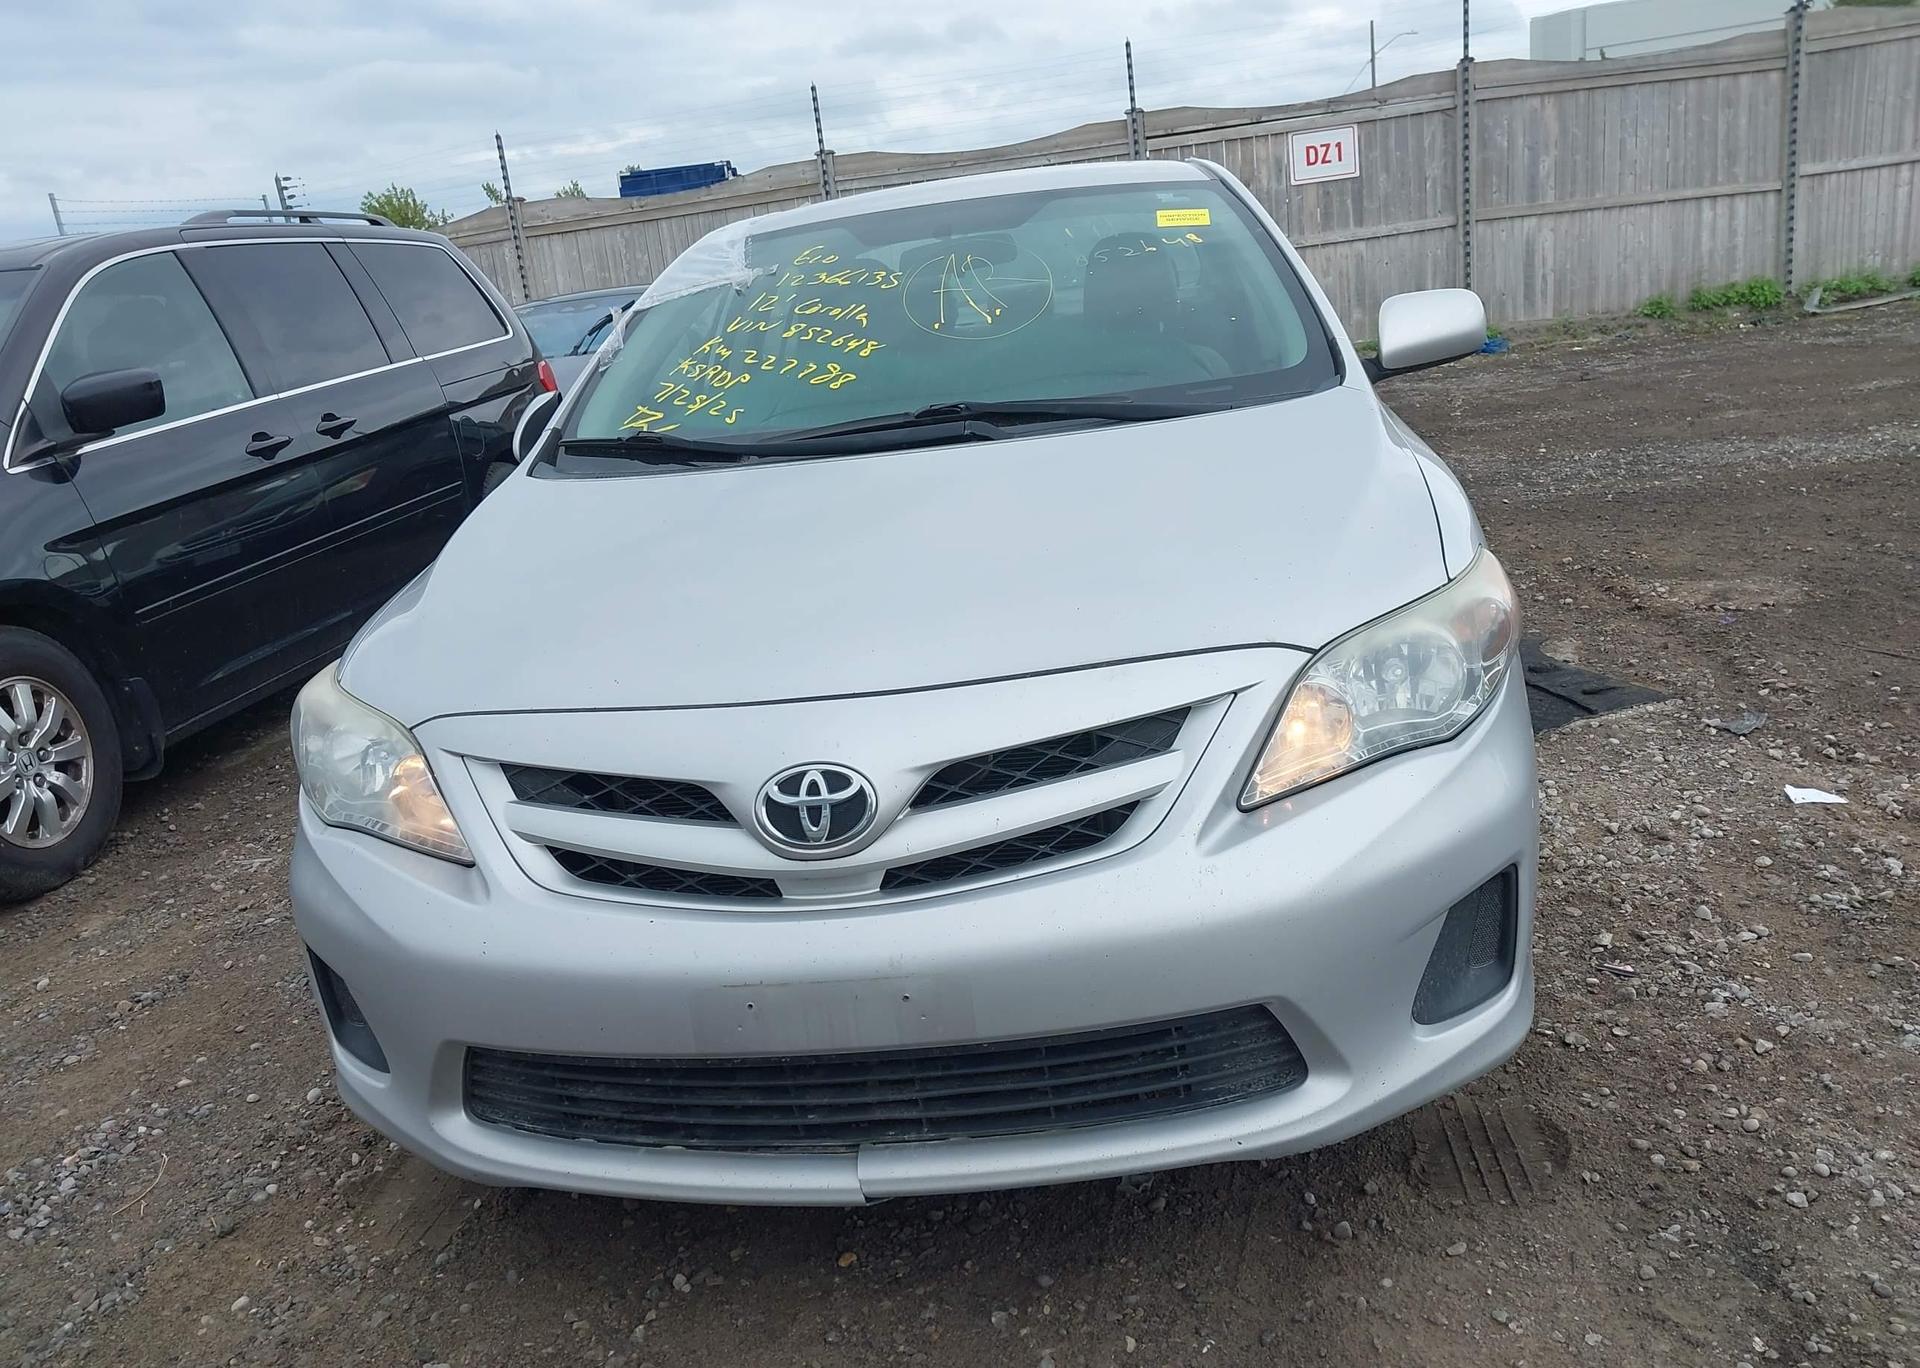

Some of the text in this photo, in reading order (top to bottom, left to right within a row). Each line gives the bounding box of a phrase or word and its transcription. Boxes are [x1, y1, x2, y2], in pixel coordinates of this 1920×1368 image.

[1305, 141, 1343, 166] DZ1
[794, 298, 868, 328] Corolla
[727, 316, 887, 357] VIN 852648
